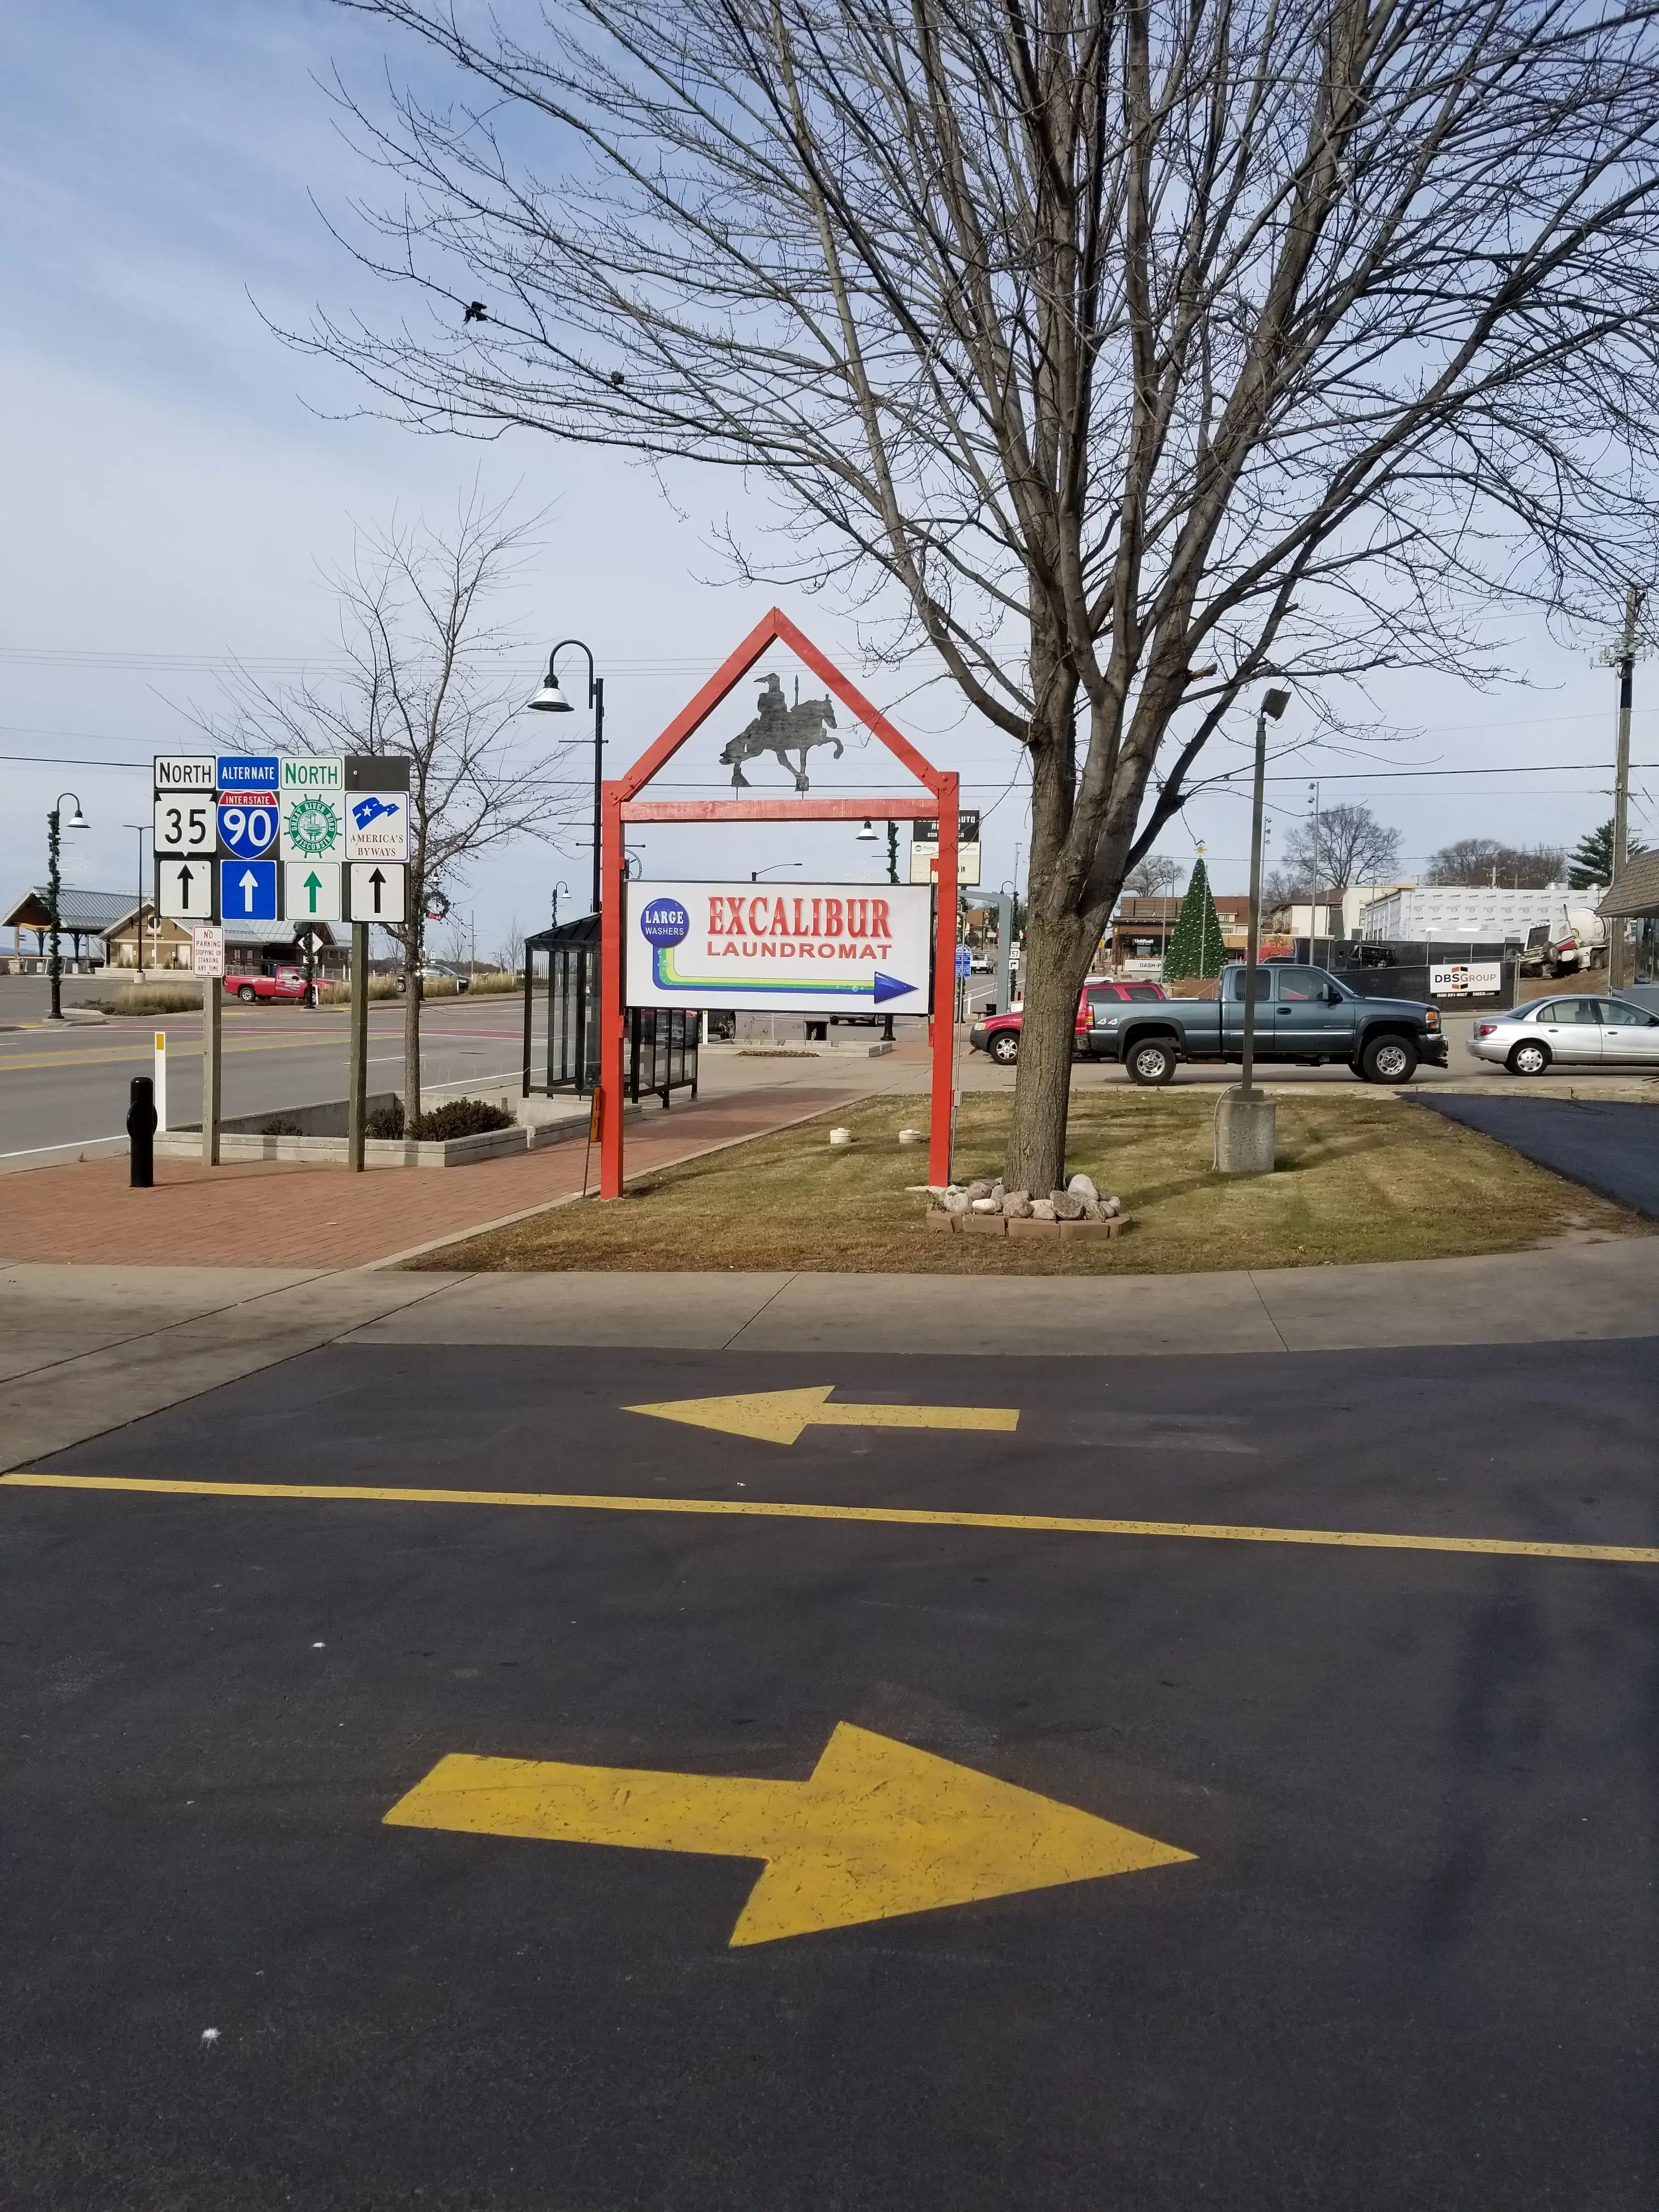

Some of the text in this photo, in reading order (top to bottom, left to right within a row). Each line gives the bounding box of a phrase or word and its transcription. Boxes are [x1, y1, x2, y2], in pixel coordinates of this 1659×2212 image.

[159, 761, 211, 783] NORTH
[222, 766, 275, 780] ALTERNATE
[285, 763, 338, 785] NORTH
[225, 795, 270, 805] INTERSTATE
[291, 802, 335, 831] GREAT RIVER ROAD
[164, 808, 206, 845] 35
[223, 808, 272, 847] 90
[295, 834, 332, 850] WISCONSIN
[350, 834, 404, 843] AMERICA'S
[357, 847, 396, 857] BYWAYS
[645, 910, 685, 925] LARGE
[707, 896, 893, 939] EXCALIBUR
[204, 930, 213, 939] NO
[645, 927, 684, 936] WASHERS
[707, 941, 893, 960] LAUNDROMAT
